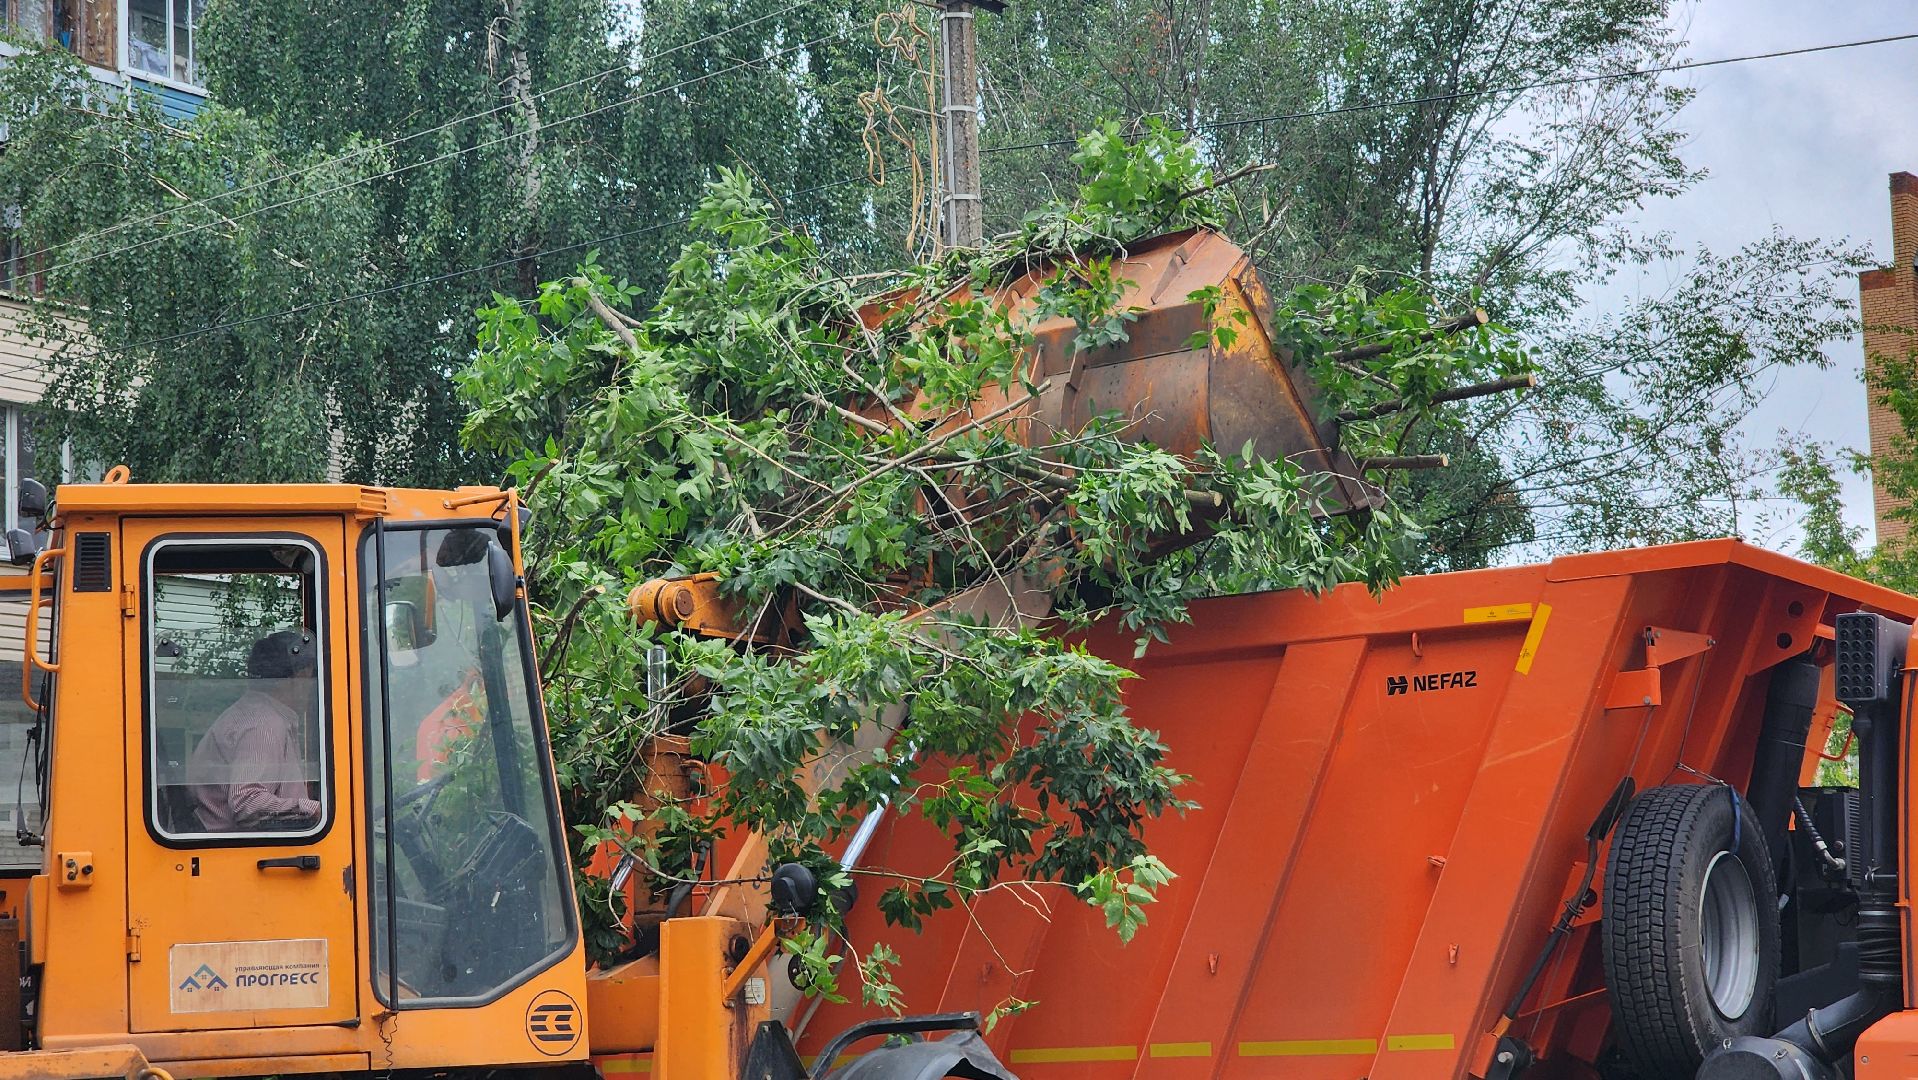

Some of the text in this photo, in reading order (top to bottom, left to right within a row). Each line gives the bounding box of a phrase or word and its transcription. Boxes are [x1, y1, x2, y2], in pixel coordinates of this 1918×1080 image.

[1413, 671, 1477, 692] NEFAZ
[234, 964, 284, 973] управляющая
[236, 972, 319, 987] ПРОГРЕСС
